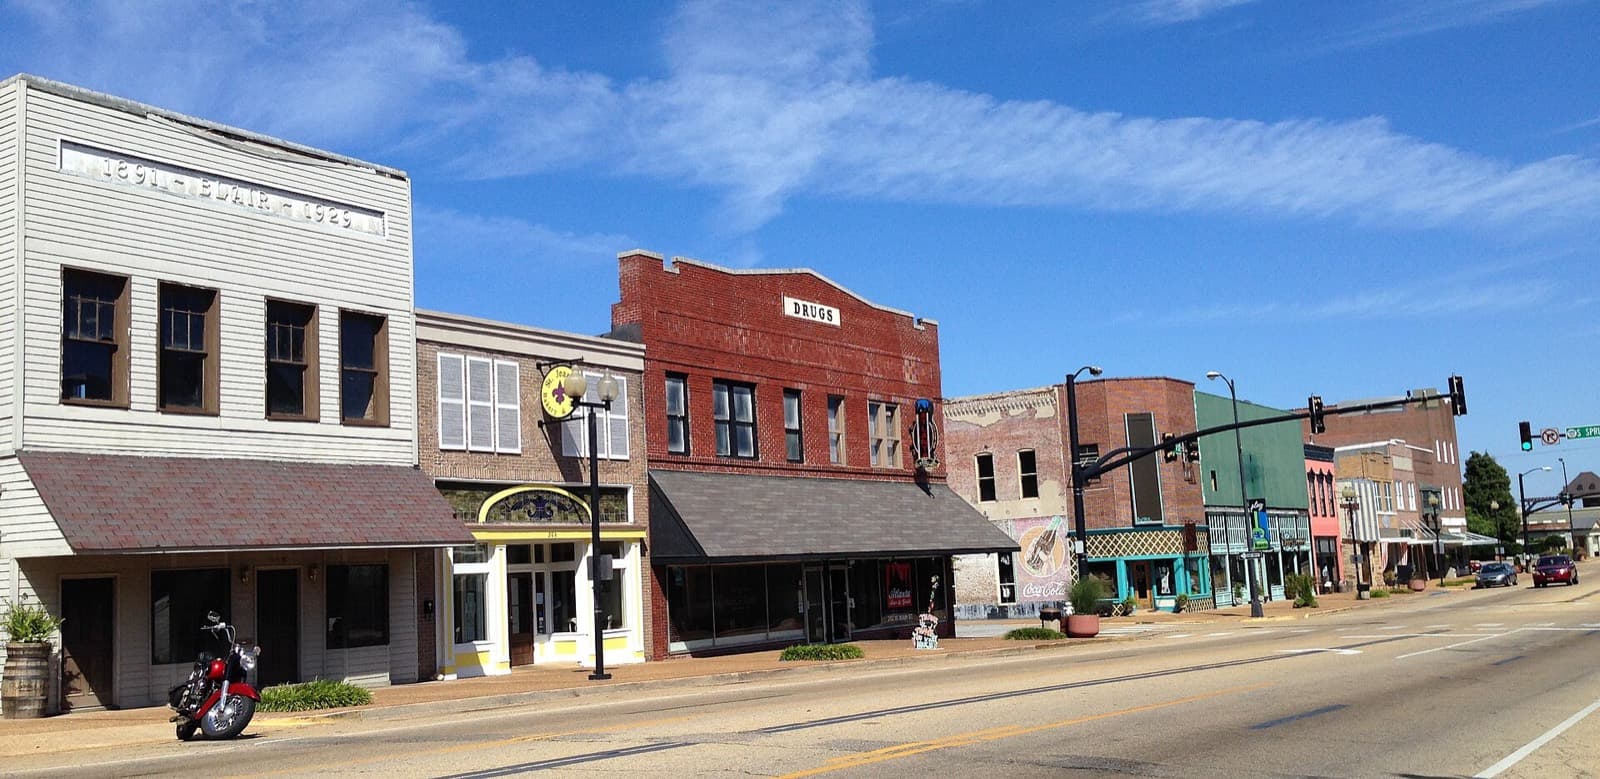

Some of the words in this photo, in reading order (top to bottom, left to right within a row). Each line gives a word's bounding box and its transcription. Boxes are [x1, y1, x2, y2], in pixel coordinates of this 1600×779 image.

[103, 158, 158, 187] 1891
[199, 178, 270, 210] BLAIR
[303, 202, 352, 228] 1929
[793, 301, 833, 322] DRUGS
[1577, 429, 1582, 437] S
